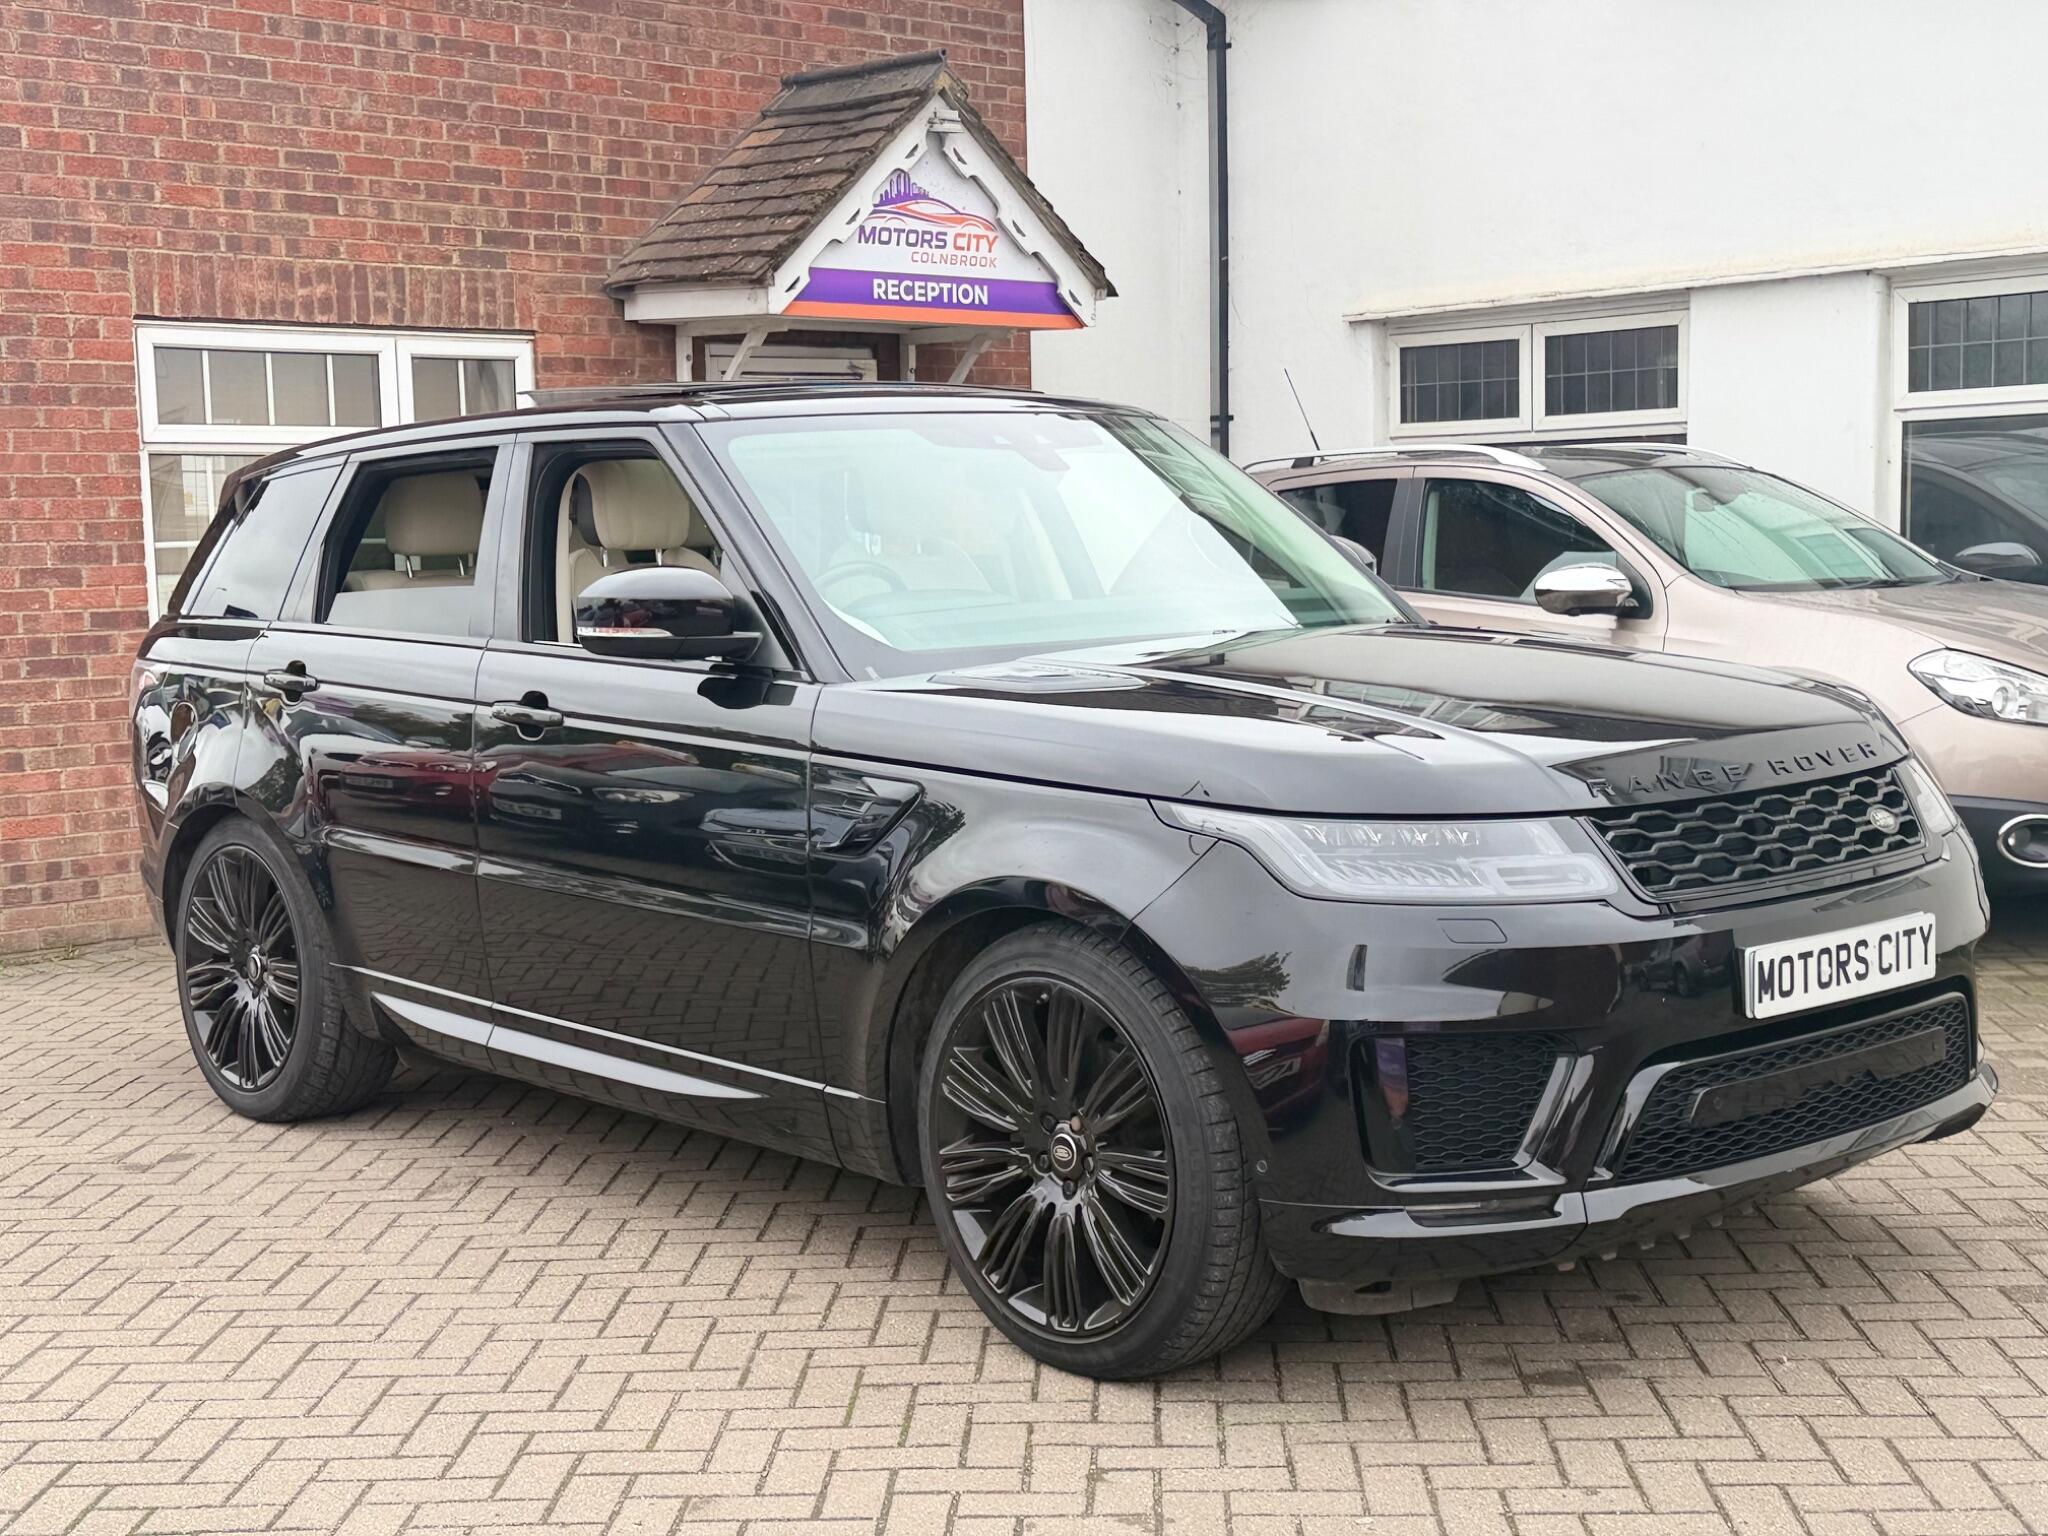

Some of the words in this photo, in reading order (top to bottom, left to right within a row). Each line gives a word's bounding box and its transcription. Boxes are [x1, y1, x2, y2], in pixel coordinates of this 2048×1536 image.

[858, 225, 947, 250] MOTORS
[953, 232, 998, 252] CITY
[911, 251, 997, 268] COLNBROOK
[873, 278, 988, 305] RECEPTION
[1585, 764, 1748, 798] RANGE
[1767, 742, 1878, 775] ROVER
[1758, 938, 1870, 1004] MOTORS
[1878, 923, 1934, 976] CITY
